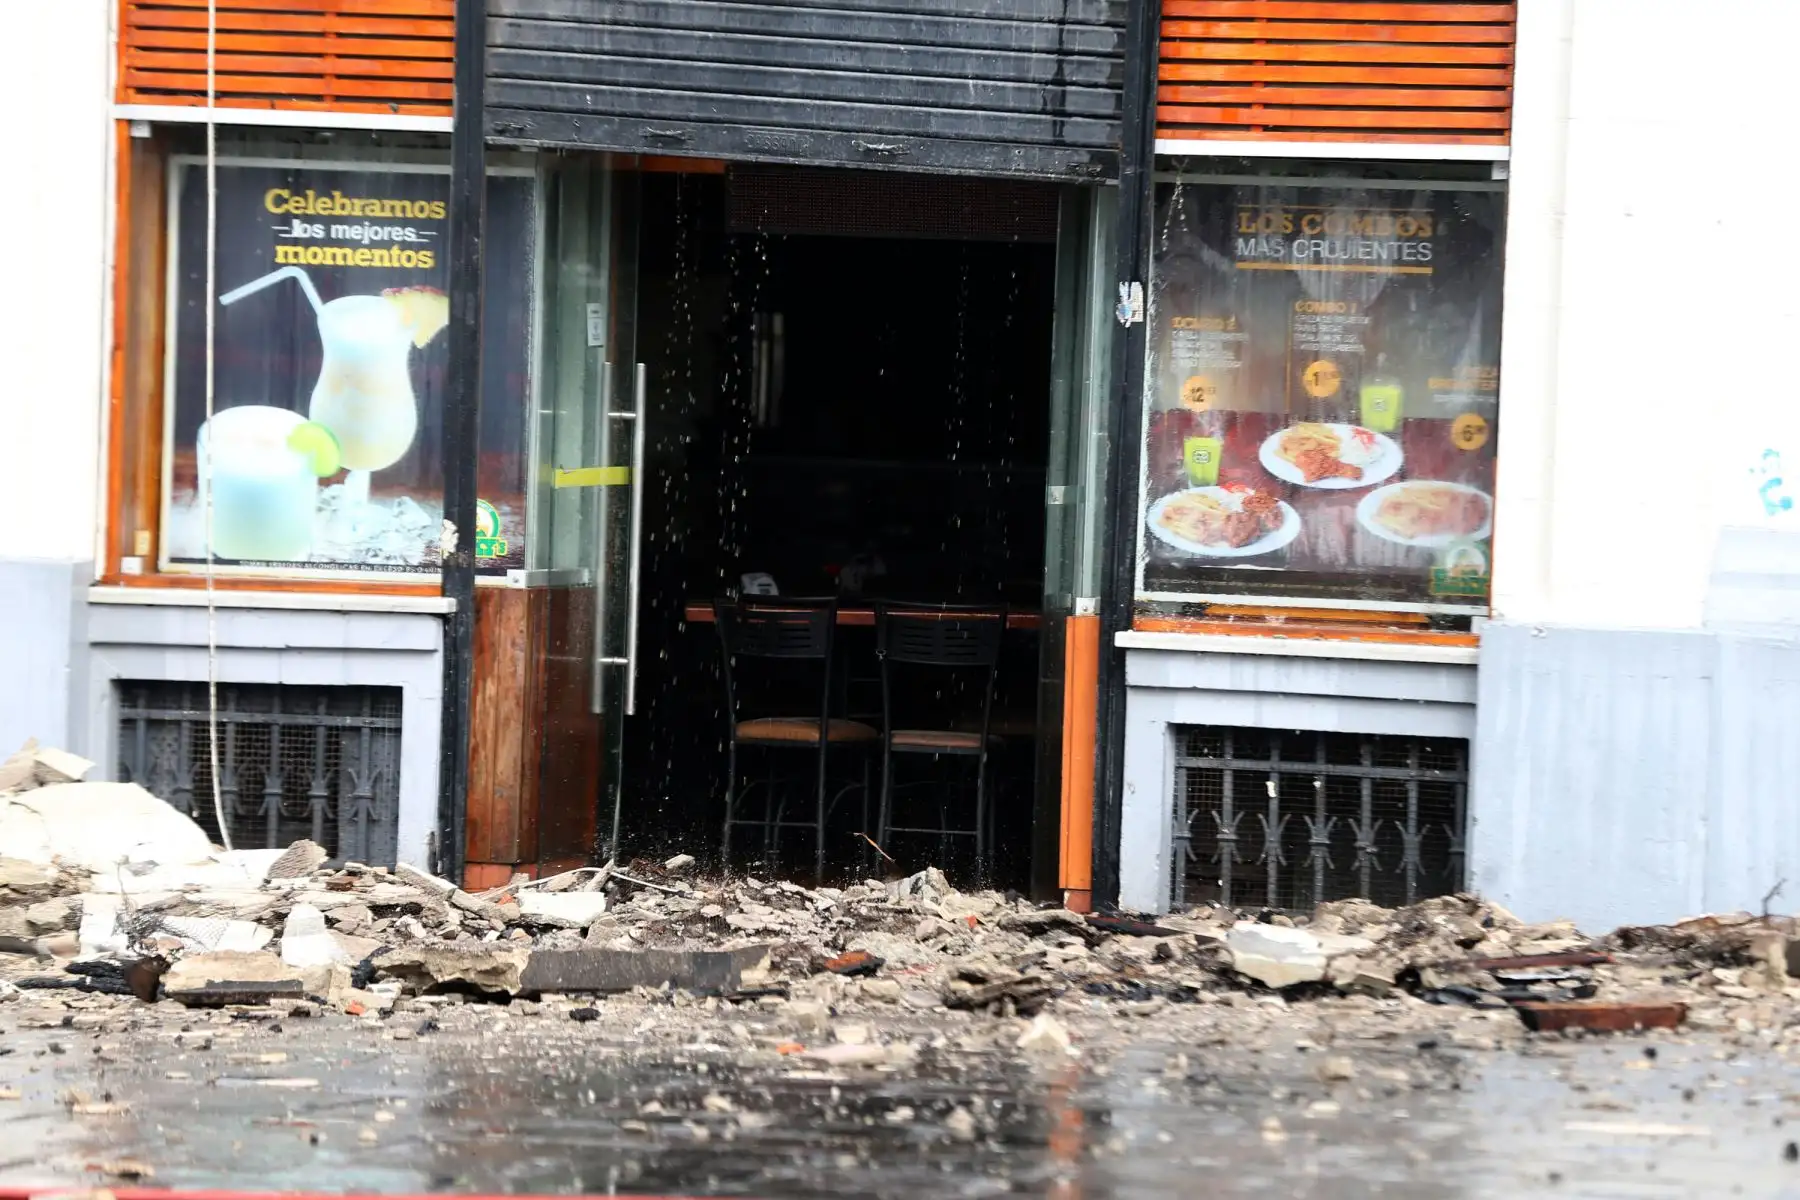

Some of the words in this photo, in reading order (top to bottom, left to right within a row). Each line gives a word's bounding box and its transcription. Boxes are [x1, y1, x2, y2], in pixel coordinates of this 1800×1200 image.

[265, 188, 446, 219] Celebramos
[291, 219, 325, 238] los
[330, 221, 417, 245] mejores
[1238, 211, 1293, 234] LOS
[1301, 212, 1432, 238] COMBOS
[275, 244, 435, 269] momentos
[1292, 239, 1432, 261] CRUJIENTES
